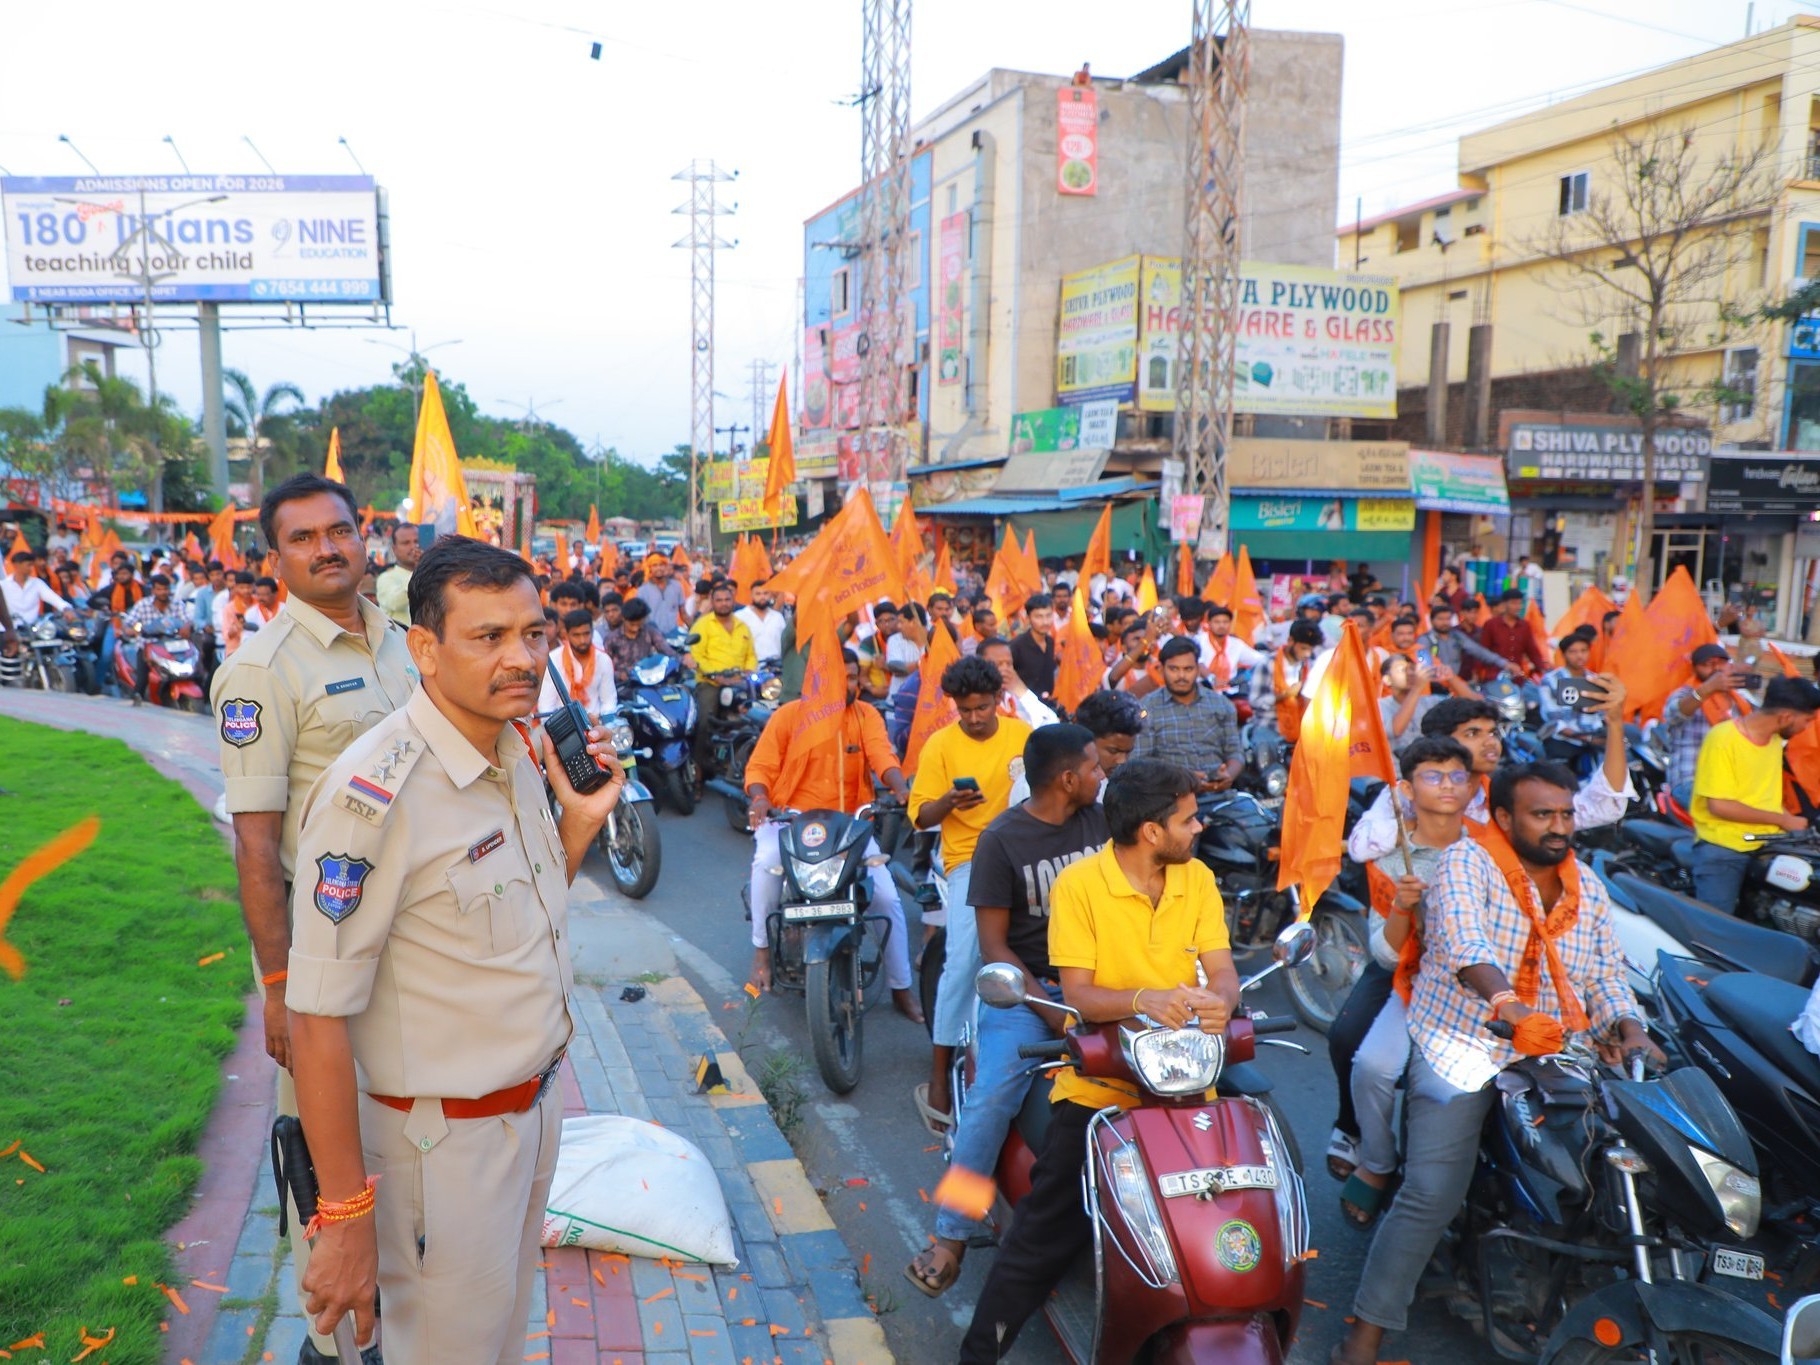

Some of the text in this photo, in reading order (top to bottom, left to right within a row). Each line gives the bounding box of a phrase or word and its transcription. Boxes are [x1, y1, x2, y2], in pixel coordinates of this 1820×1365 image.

[75, 177, 285, 192] ADMISSIONS OPEN FOR 2026
[17, 213, 87, 245] 180
[298, 219, 366, 243] NINE
[25, 251, 253, 275] teaching your child
[300, 248, 367, 259] EDUCATION
[269, 281, 370, 295] 7654 444 999
[1271, 280, 1389, 314] PLYWOOD
[1304, 319, 1317, 338] &
[1326, 316, 1395, 343] GLASS
[1533, 431, 1600, 451] SHIVA
[1541, 452, 1634, 468] HARDWARE
[1257, 501, 1302, 520] Bisleri
[225, 721, 257, 729] POLICE
[344, 795, 378, 821] TSP
[322, 884, 358, 899] POLICE
[1178, 1173, 1200, 1191] TS
